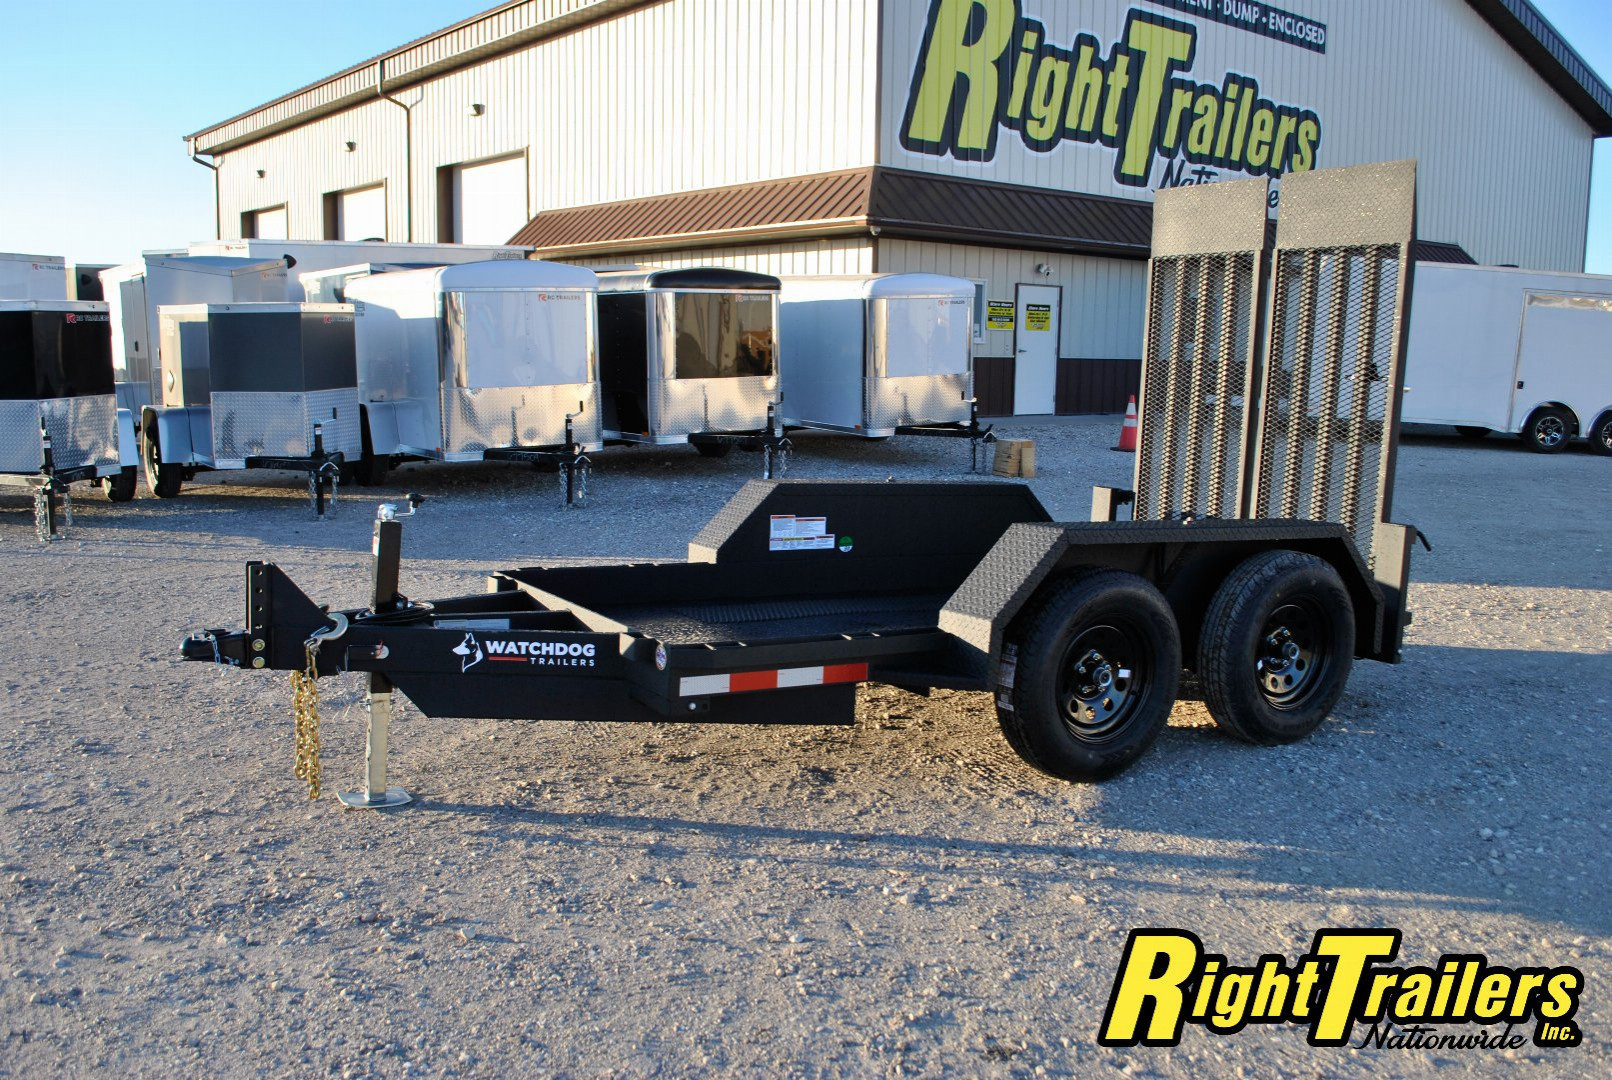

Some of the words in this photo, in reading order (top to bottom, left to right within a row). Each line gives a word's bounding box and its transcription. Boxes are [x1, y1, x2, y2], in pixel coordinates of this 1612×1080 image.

[1223, 1, 1260, 24] DUMP
[1269, 12, 1325, 45] ENCLOSED
[485, 640, 596, 657] WATCHDOG
[530, 657, 595, 667] TRAILERS
